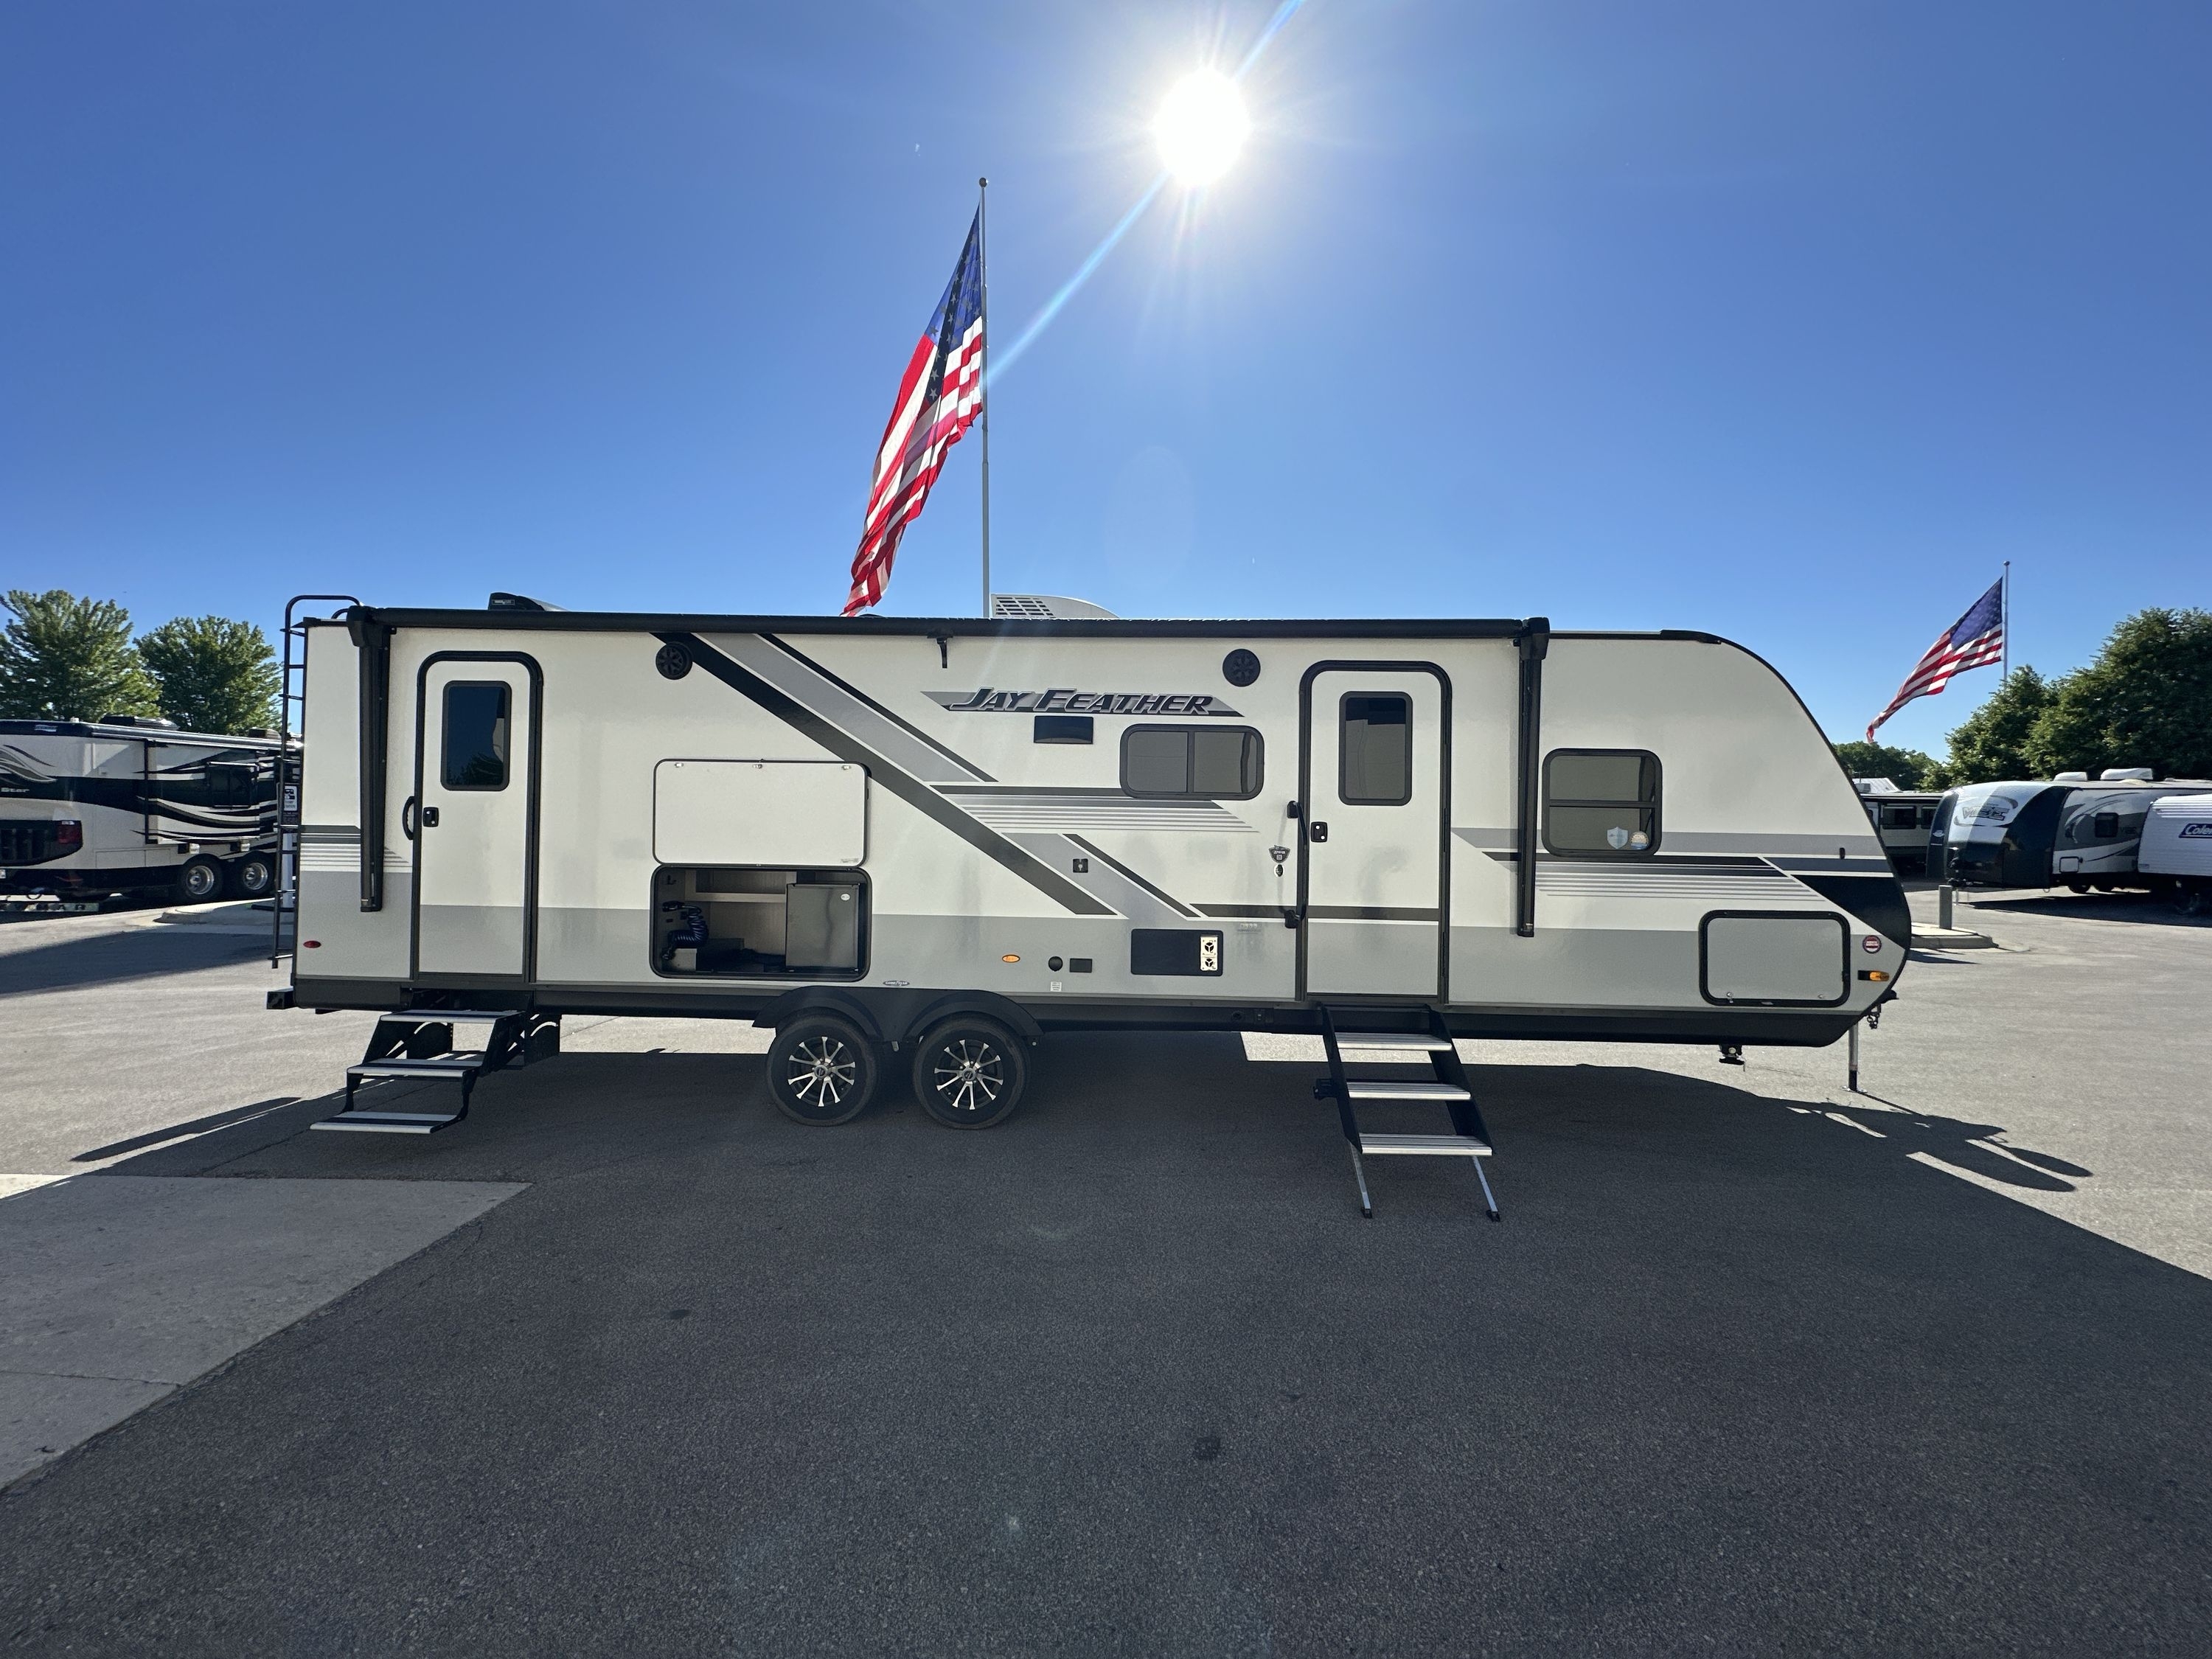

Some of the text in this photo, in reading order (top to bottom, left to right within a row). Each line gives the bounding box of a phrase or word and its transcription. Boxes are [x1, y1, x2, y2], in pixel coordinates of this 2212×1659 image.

[950, 686, 1213, 714] JAY FEATHER
[2185, 824, 2212, 835] Cole
